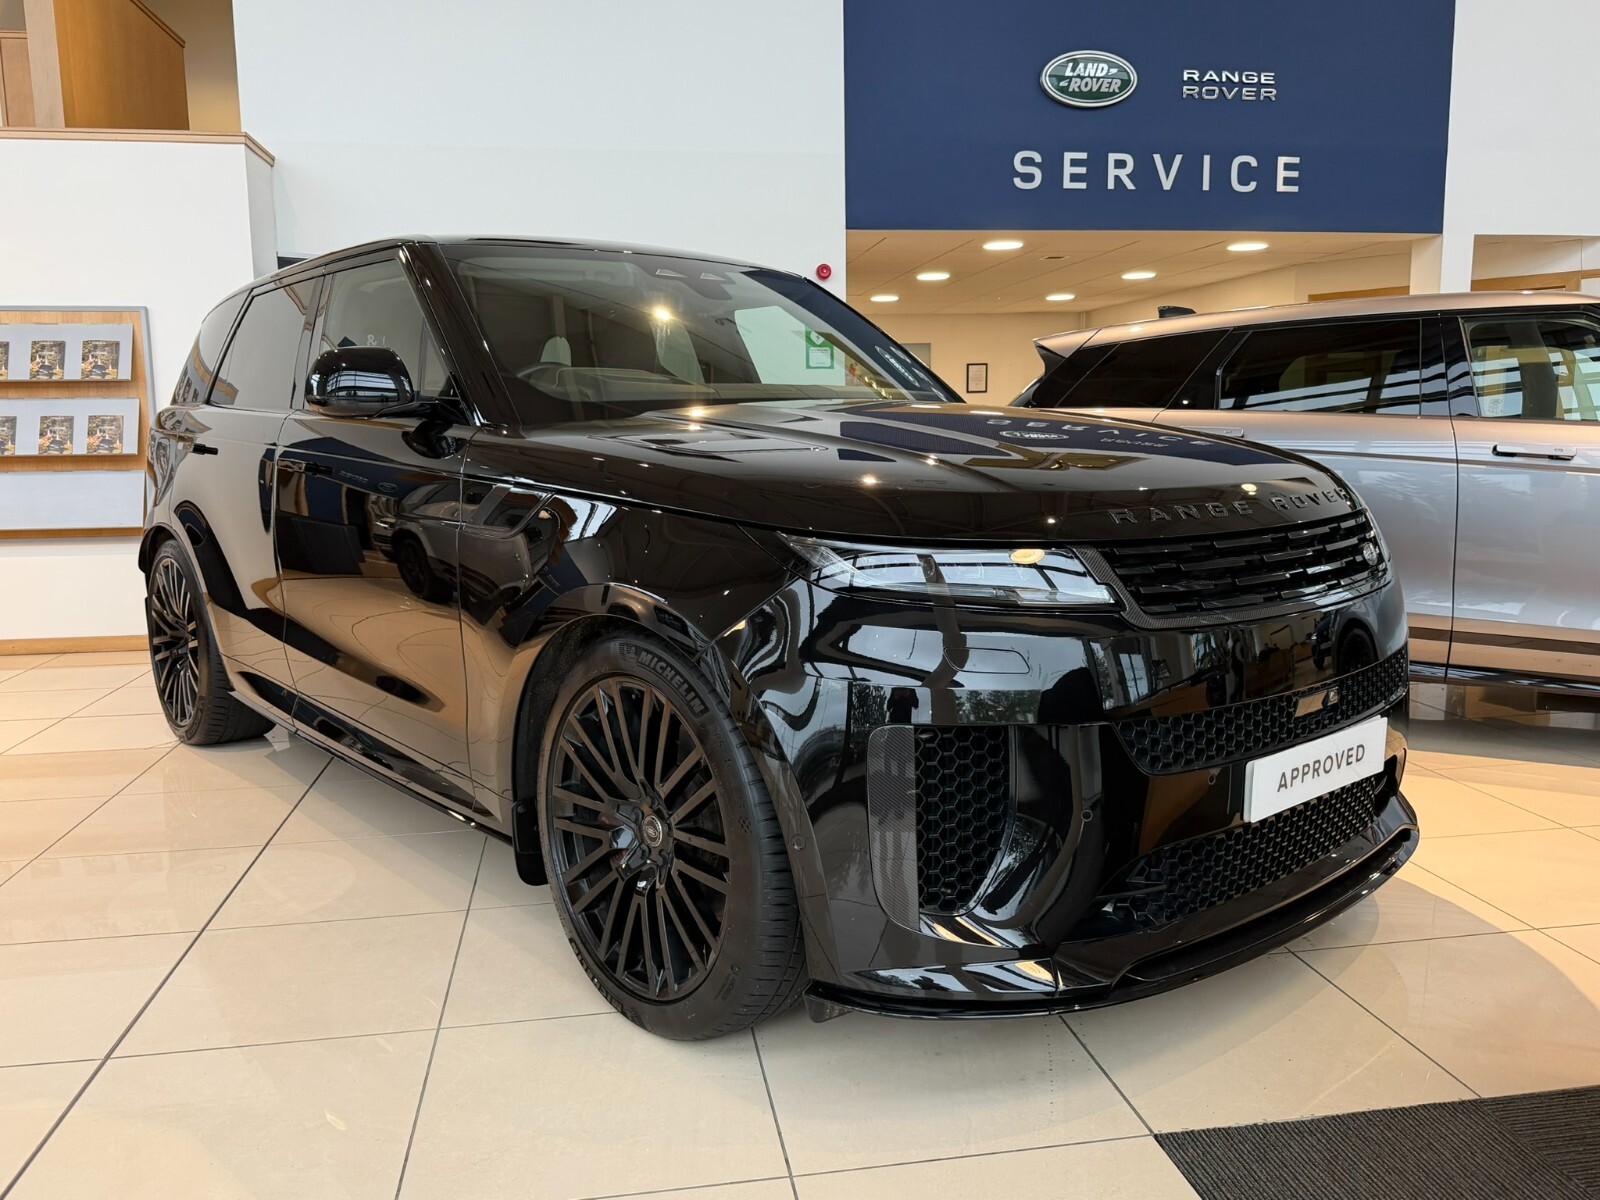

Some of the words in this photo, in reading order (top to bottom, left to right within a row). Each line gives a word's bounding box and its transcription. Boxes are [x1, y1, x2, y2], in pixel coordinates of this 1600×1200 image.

[1065, 62, 1109, 77] LAND
[1183, 69, 1275, 84] RANGE
[1068, 77, 1122, 92] ROVER
[1182, 85, 1277, 101] ROVER
[1012, 150, 1301, 193] SERVICE
[1108, 501, 1254, 524] RANGE
[1270, 486, 1350, 512] ROVER
[638, 650, 707, 714] MICHELIN
[1277, 744, 1366, 793] APPROVED
